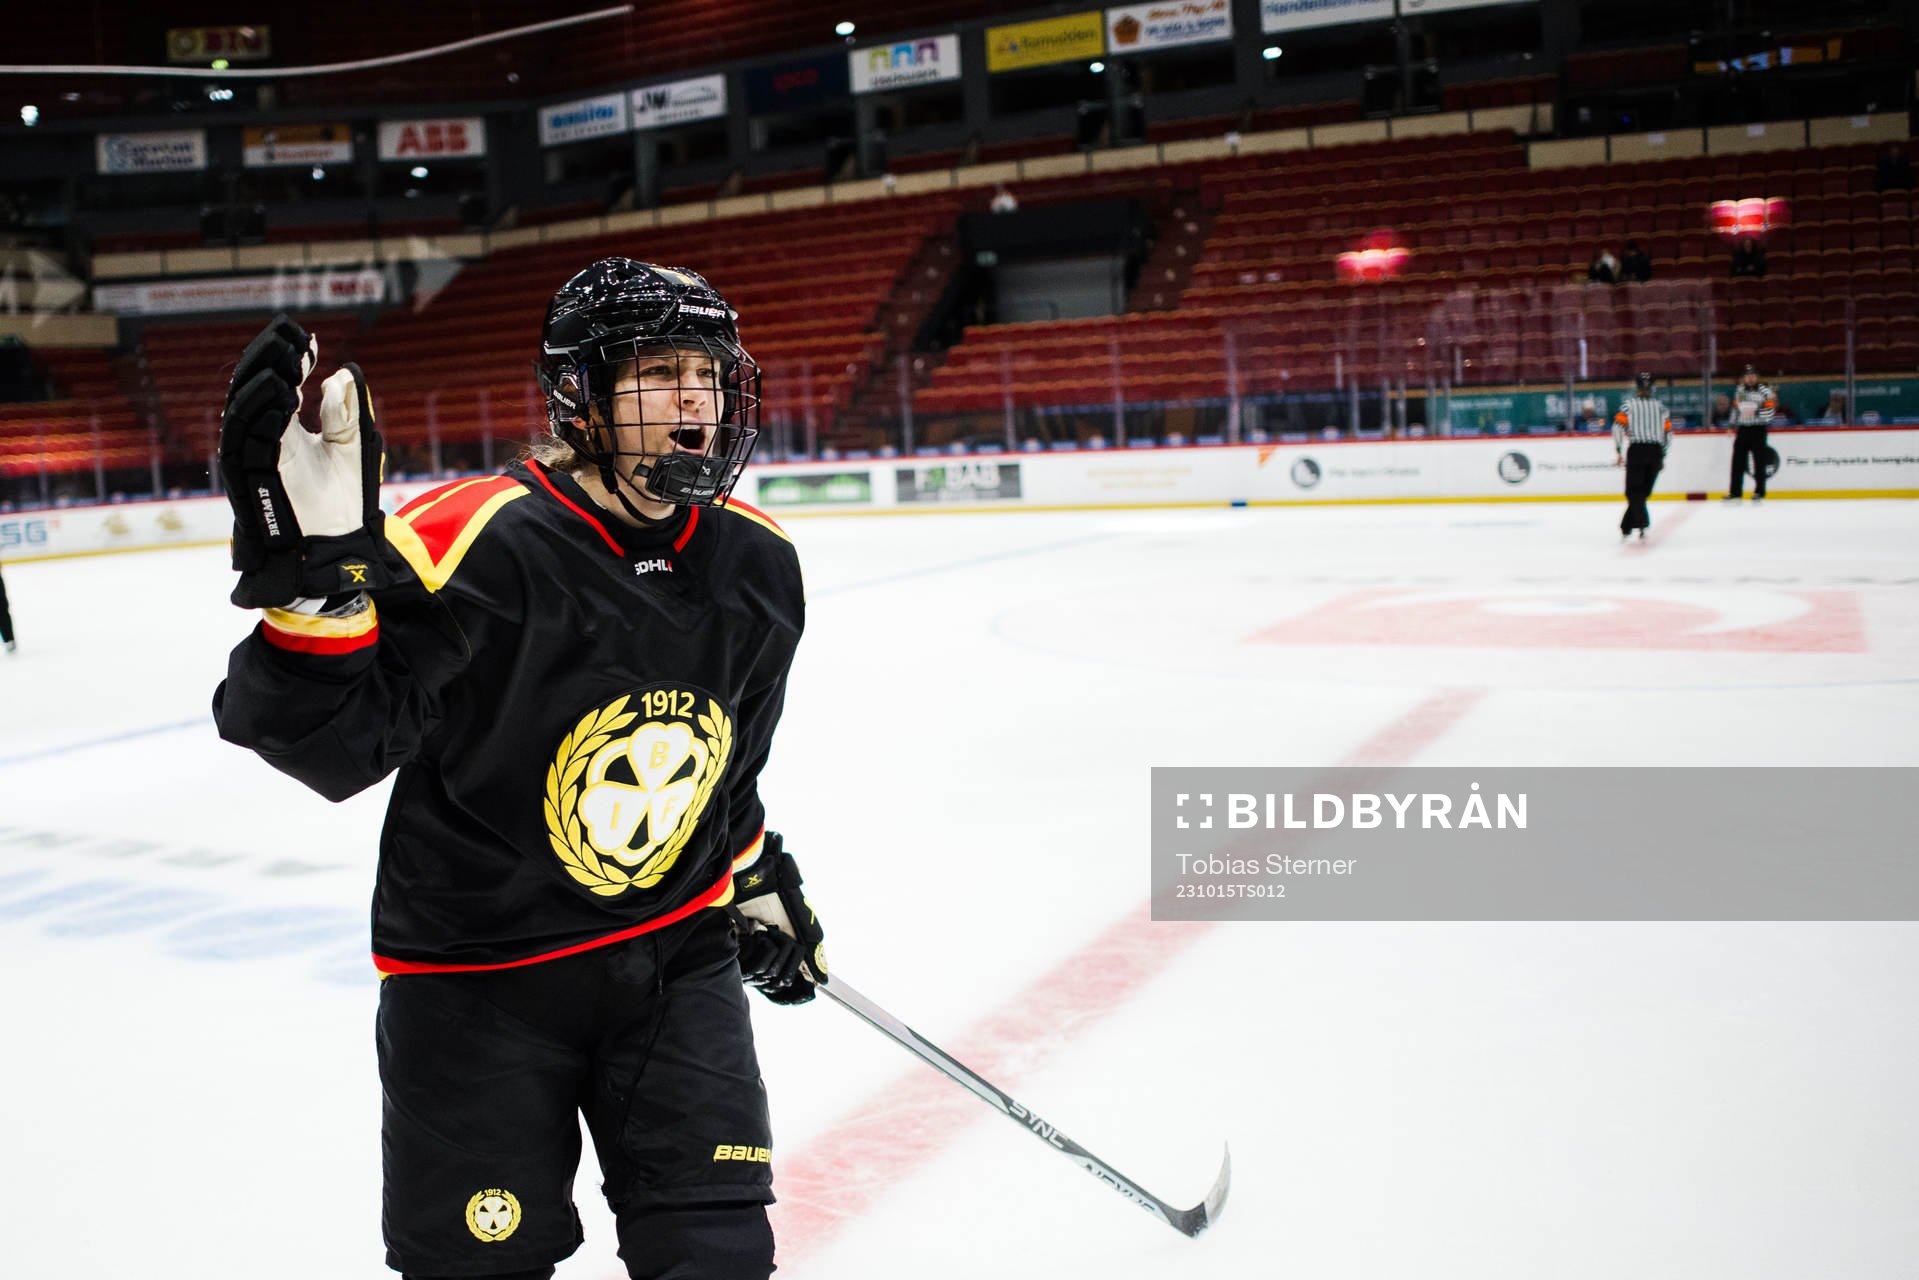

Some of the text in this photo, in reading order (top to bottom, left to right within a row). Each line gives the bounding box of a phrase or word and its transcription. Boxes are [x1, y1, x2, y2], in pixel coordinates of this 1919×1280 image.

[397, 122, 468, 155] ABB
[679, 304, 726, 319] BAUER
[641, 690, 695, 719] 1912
[649, 741, 670, 769] B
[1009, 1100, 1069, 1149] SYNC
[484, 1188, 502, 1197] 1912
